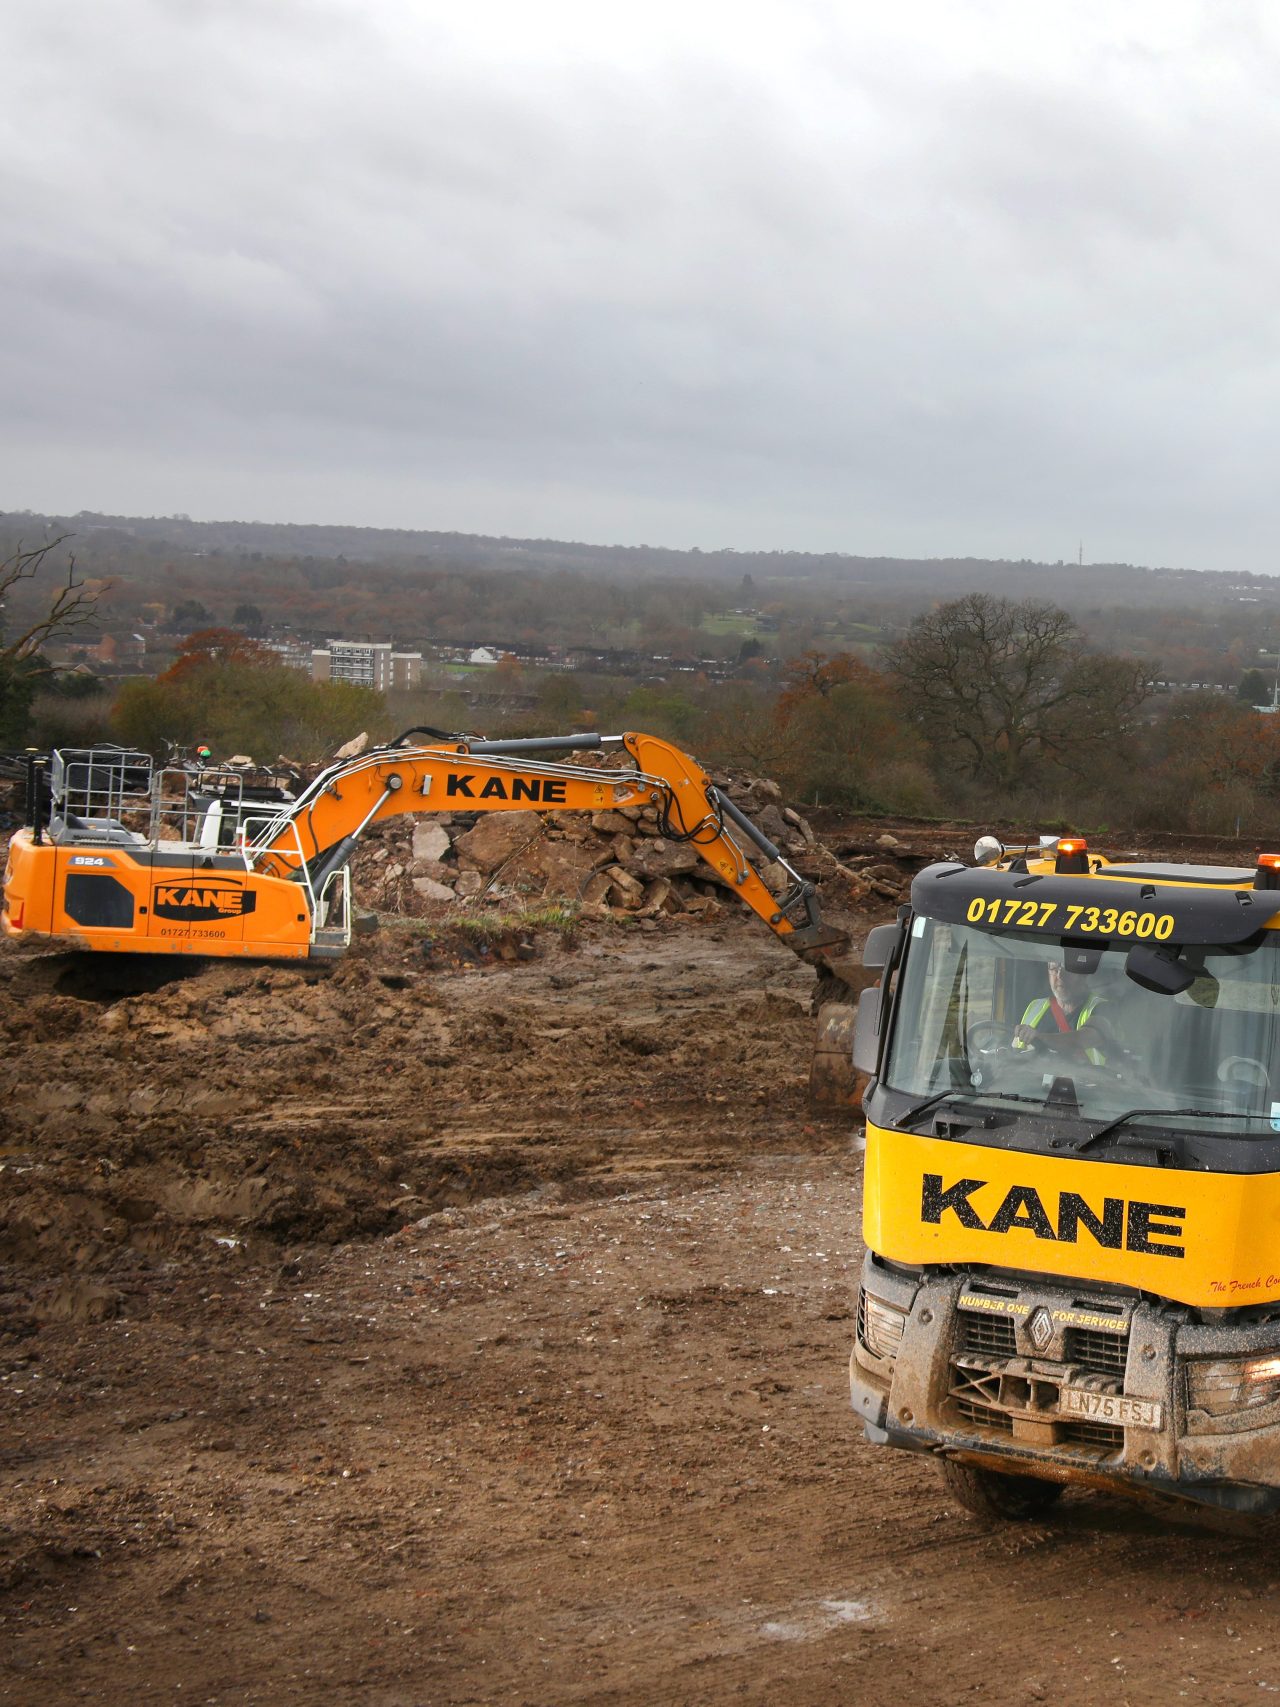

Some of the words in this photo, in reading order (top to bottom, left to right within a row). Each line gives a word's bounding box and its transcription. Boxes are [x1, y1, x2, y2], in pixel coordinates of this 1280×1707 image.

[446, 774, 567, 803] KANE
[74, 857, 105, 866] 924
[157, 887, 243, 909] KANE
[218, 907, 242, 915] Group
[966, 897, 1057, 928] 01727
[1064, 905, 1175, 940] 733600
[160, 928, 189, 937] 01727
[921, 1173, 1186, 1259] KANE
[1210, 1281, 1227, 1293] The
[1229, 1278, 1261, 1293] French
[960, 1295, 1005, 1311] NUMBER
[1006, 1304, 1030, 1316] ONE
[1052, 1310, 1075, 1322] FOR
[1076, 1314, 1129, 1331] SERVICE!
[1066, 1389, 1114, 1417] LN75
